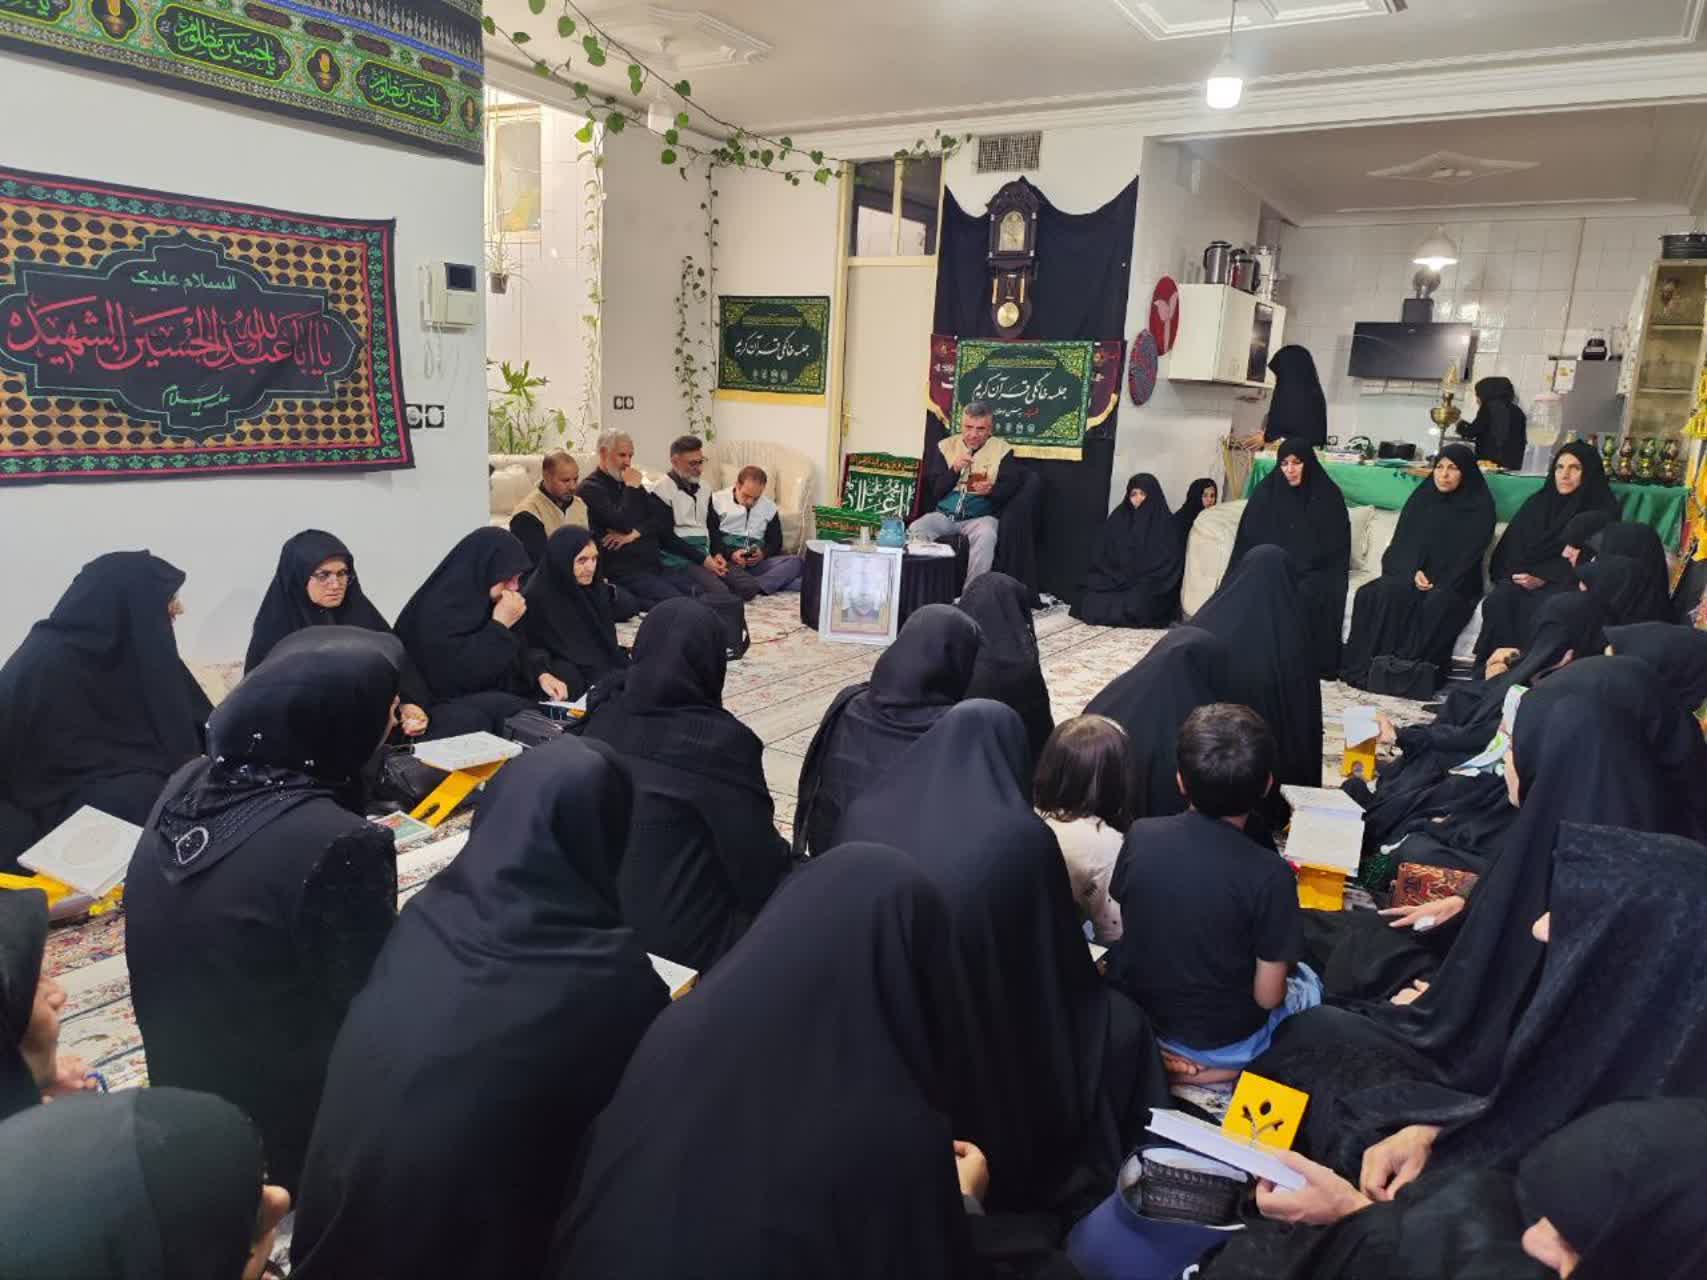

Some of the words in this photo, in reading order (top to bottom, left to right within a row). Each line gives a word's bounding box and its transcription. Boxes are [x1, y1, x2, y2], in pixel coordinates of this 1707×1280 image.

[179, 270, 237, 297] السلام
[971, 372, 1002, 402] کریم
[987, 376, 1031, 401] قرآن
[1024, 371, 1052, 405] خانگی
[1047, 384, 1068, 401] جلسه
